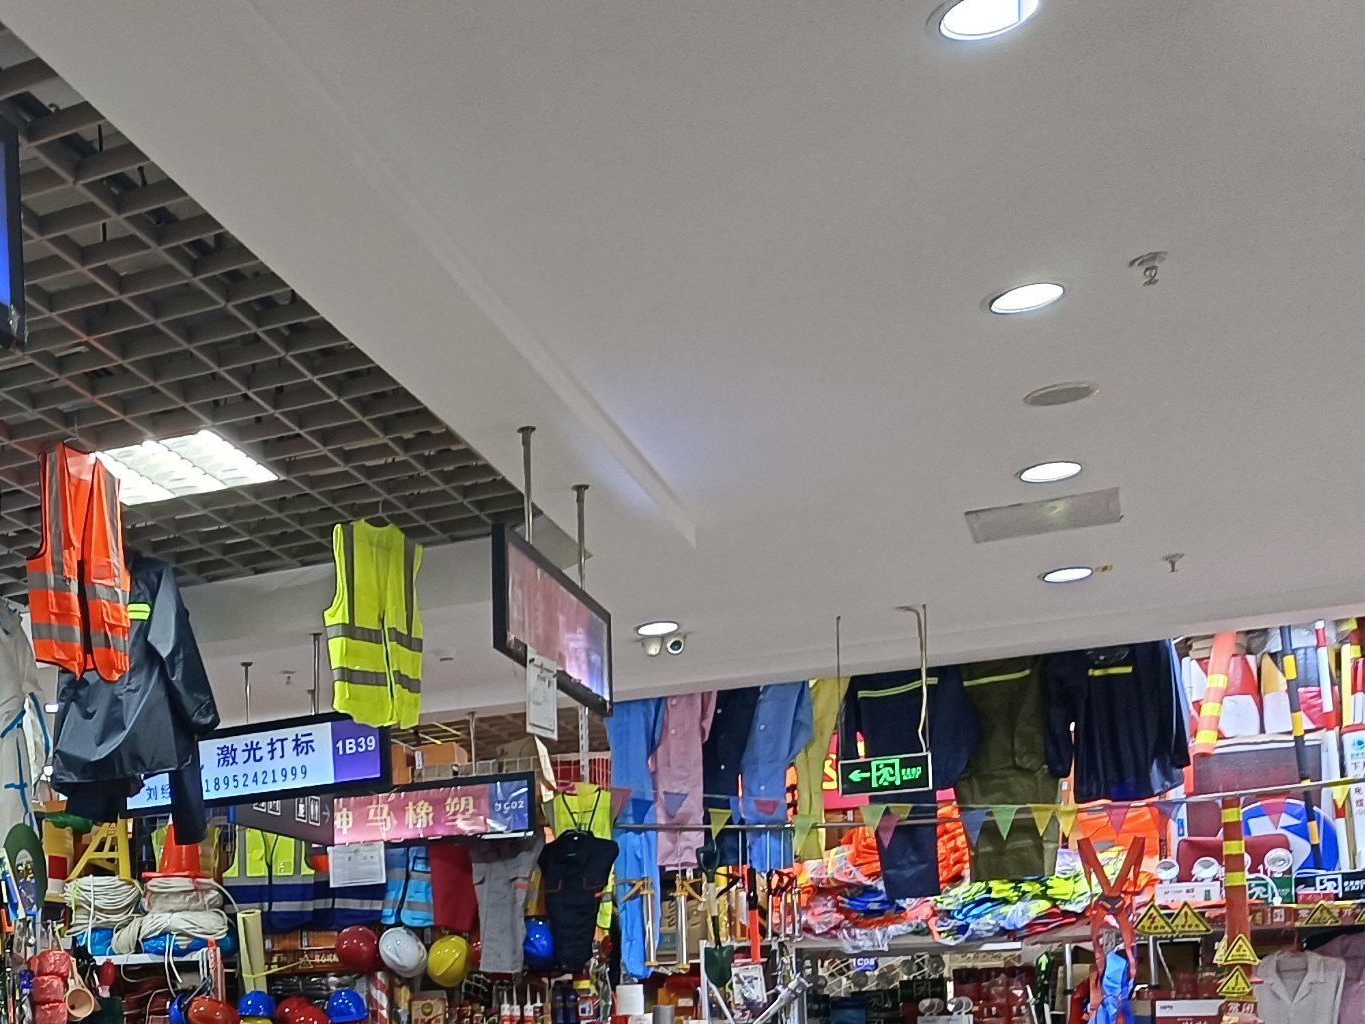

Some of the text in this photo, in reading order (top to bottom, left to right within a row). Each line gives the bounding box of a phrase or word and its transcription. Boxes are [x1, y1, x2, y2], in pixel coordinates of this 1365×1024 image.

[217, 732, 316, 768] 激光打标
[335, 736, 377, 755] 1B39
[204, 765, 309, 793] 18952421999
